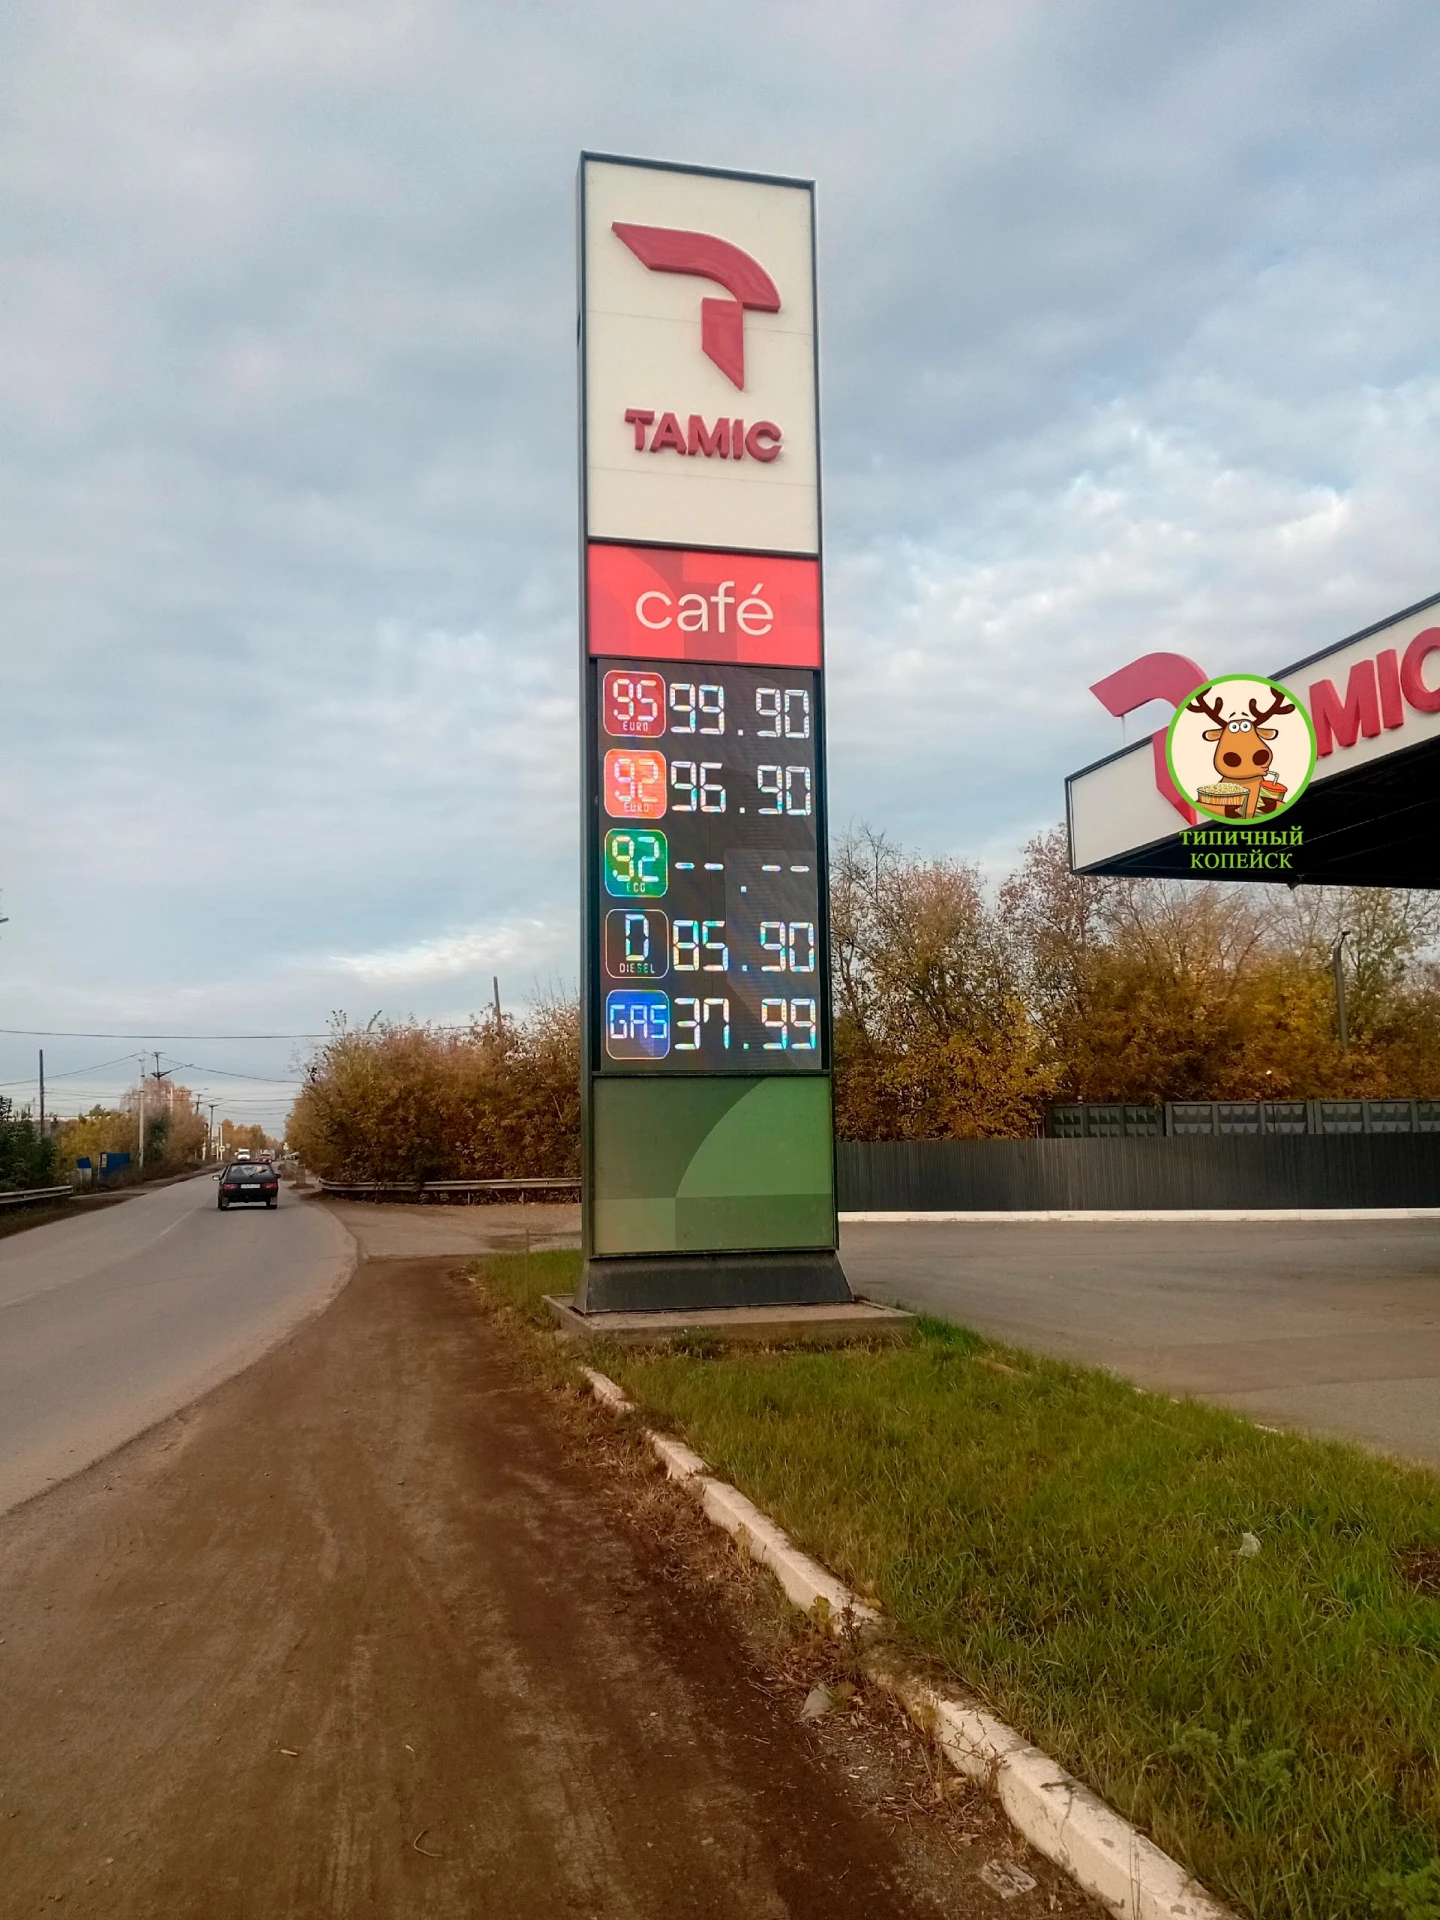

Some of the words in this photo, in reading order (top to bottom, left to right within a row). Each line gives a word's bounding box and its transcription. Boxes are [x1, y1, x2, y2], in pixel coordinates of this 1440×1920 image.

[624, 408, 783, 463] TAMIC
[635, 580, 774, 636] café
[612, 678, 659, 721] 95
[669, 683, 810, 739] 99.90
[1308, 626, 1440, 760] MIC
[622, 721, 649, 732] EURO
[613, 758, 659, 802] 92
[670, 760, 812, 816] 96.90
[623, 802, 650, 812] EURO
[611, 835, 660, 882] 92
[626, 882, 646, 893] ECO
[618, 962, 656, 974] DIESEL
[624, 913, 650, 961] D
[672, 919, 815, 972] 85.90
[609, 1004, 667, 1039] GAS
[674, 997, 817, 1050] 37.99
